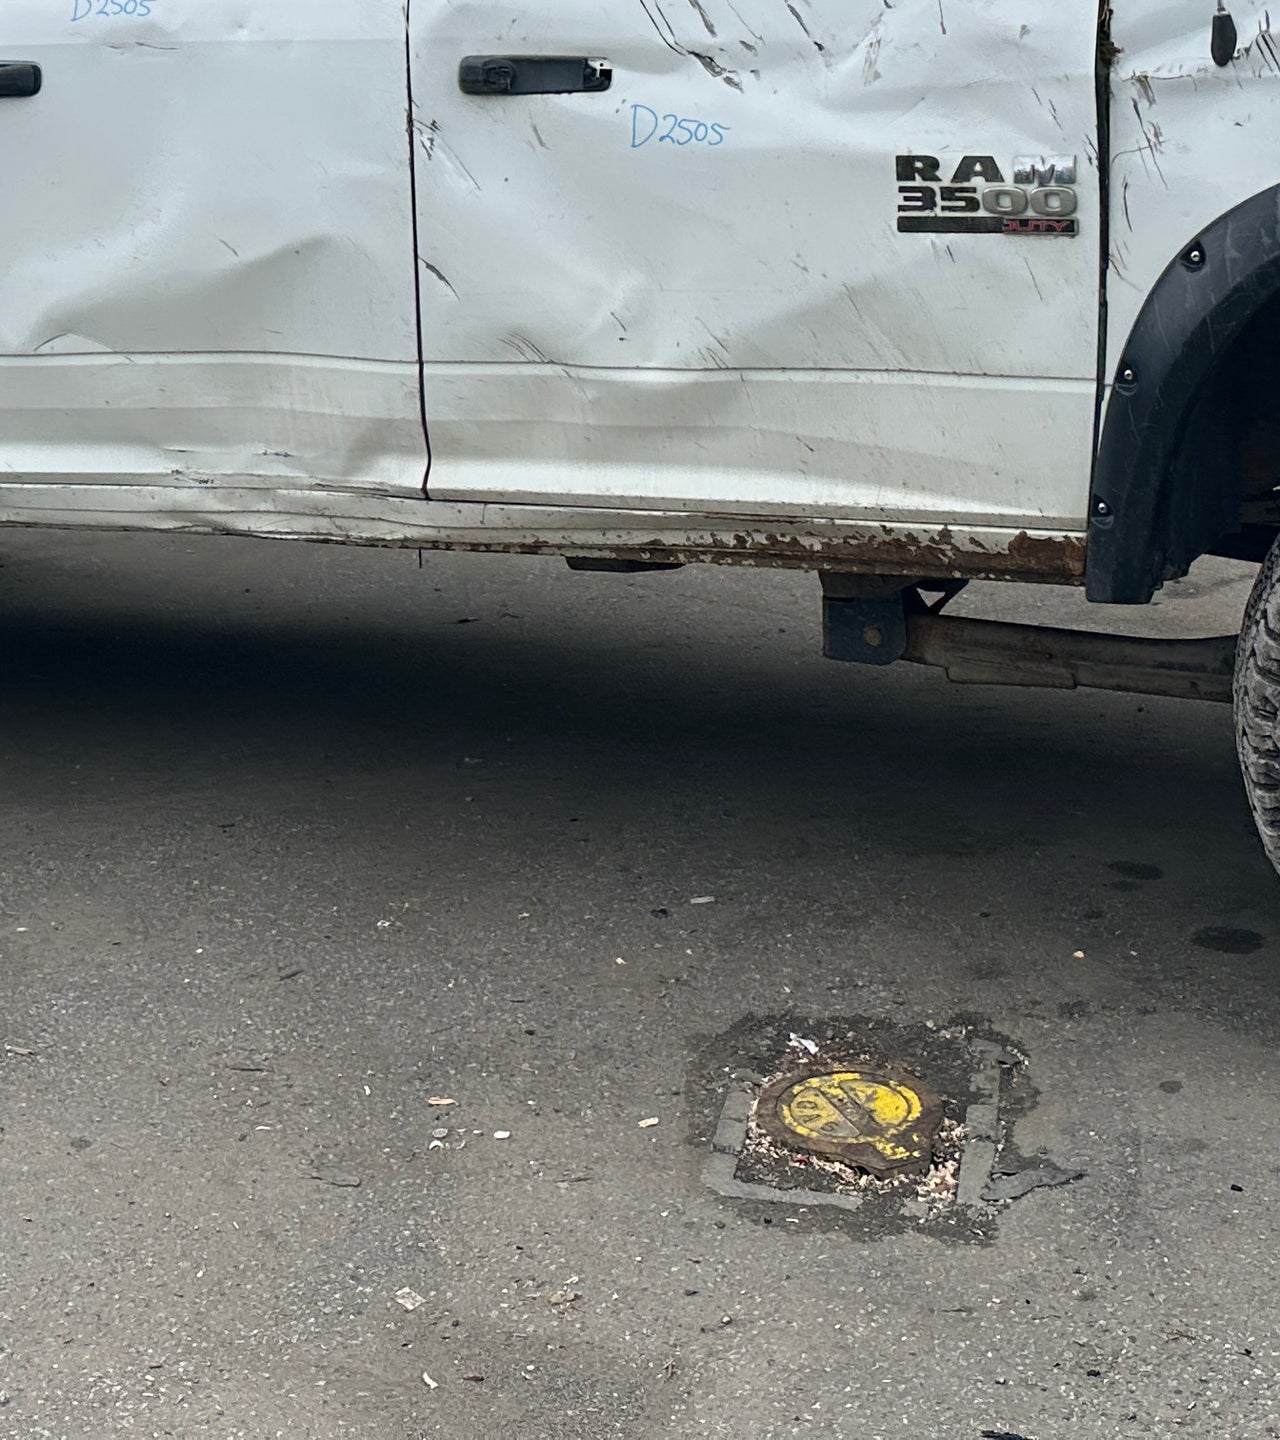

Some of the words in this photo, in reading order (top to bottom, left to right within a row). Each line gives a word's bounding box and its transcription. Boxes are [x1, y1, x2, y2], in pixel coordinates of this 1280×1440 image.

[630, 103, 732, 148] D2505
[895, 154, 1078, 185] RAM
[896, 185, 1078, 217] 3500
